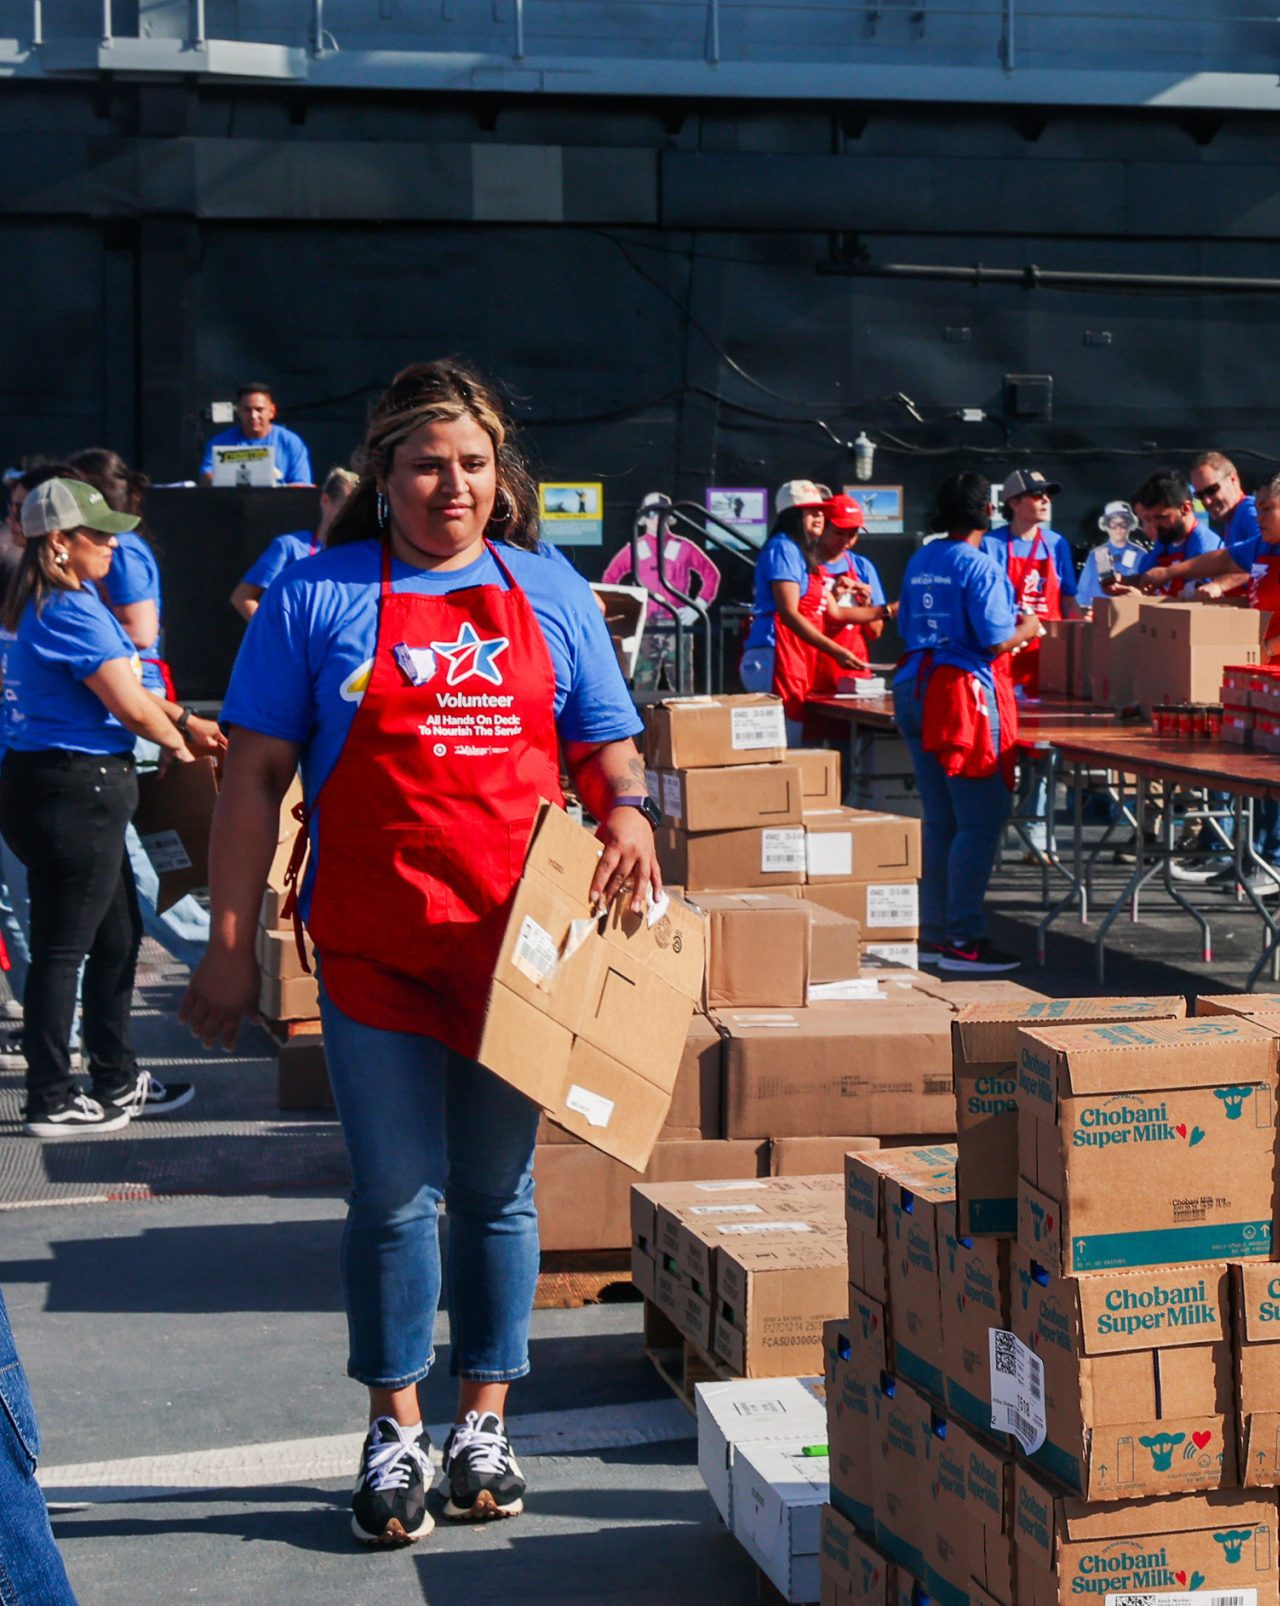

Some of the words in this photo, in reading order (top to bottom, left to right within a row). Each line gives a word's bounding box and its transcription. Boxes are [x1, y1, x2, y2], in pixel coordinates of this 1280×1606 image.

[436, 692, 514, 708] Volunteer
[418, 725, 431, 736] To
[433, 725, 473, 736] Nourish
[474, 725, 493, 736] The
[426, 715, 441, 725] All
[442, 715, 475, 725] Hands
[476, 715, 491, 725] On
[1080, 1103, 1167, 1128] Chobani
[1072, 1126, 1132, 1148] Super
[1133, 1121, 1176, 1142] Milk
[1105, 1280, 1206, 1311] Chobani
[1097, 1312, 1165, 1335] Super
[1167, 1304, 1216, 1327] Milk
[1078, 1547, 1167, 1574] Chobani
[1071, 1577, 1131, 1595] Super
[1133, 1569, 1175, 1589] Milk
